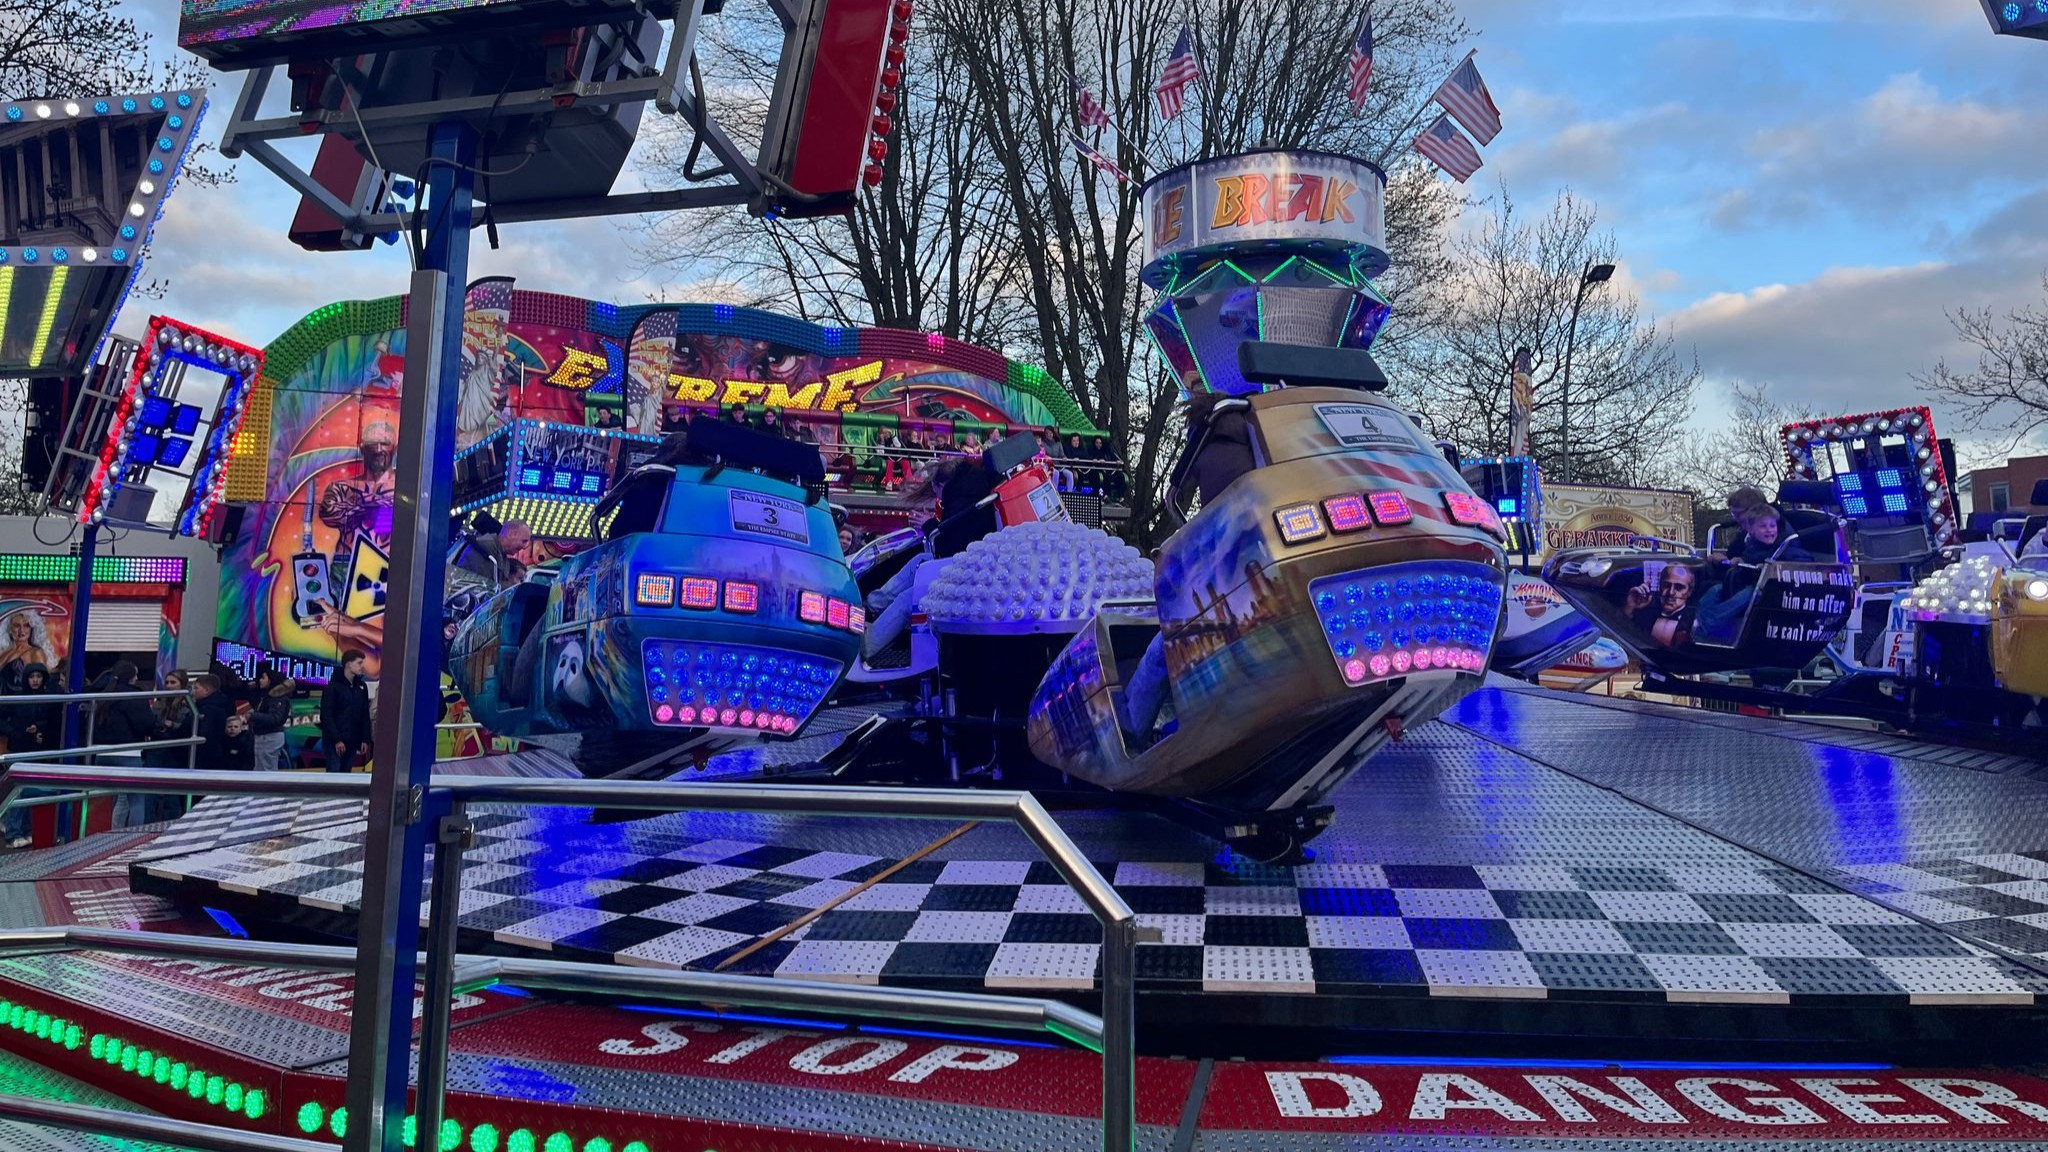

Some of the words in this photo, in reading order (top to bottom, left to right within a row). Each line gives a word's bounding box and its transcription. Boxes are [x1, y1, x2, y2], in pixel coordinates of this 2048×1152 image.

[1211, 172, 1357, 230] BREAK
[465, 311, 496, 323] NEW
[547, 339, 884, 412] EXREME
[1361, 416, 1382, 434] 4
[1044, 496, 1052, 509] 2
[763, 507, 779, 526] 3
[1793, 570, 1823, 588] gonna
[1782, 591, 1800, 610] him
[1803, 597, 1815, 611] an
[1818, 594, 1845, 614] offer
[1766, 619, 1778, 638] he
[599, 1020, 1019, 1083] STOP
[1265, 1071, 2048, 1126] DANGER
